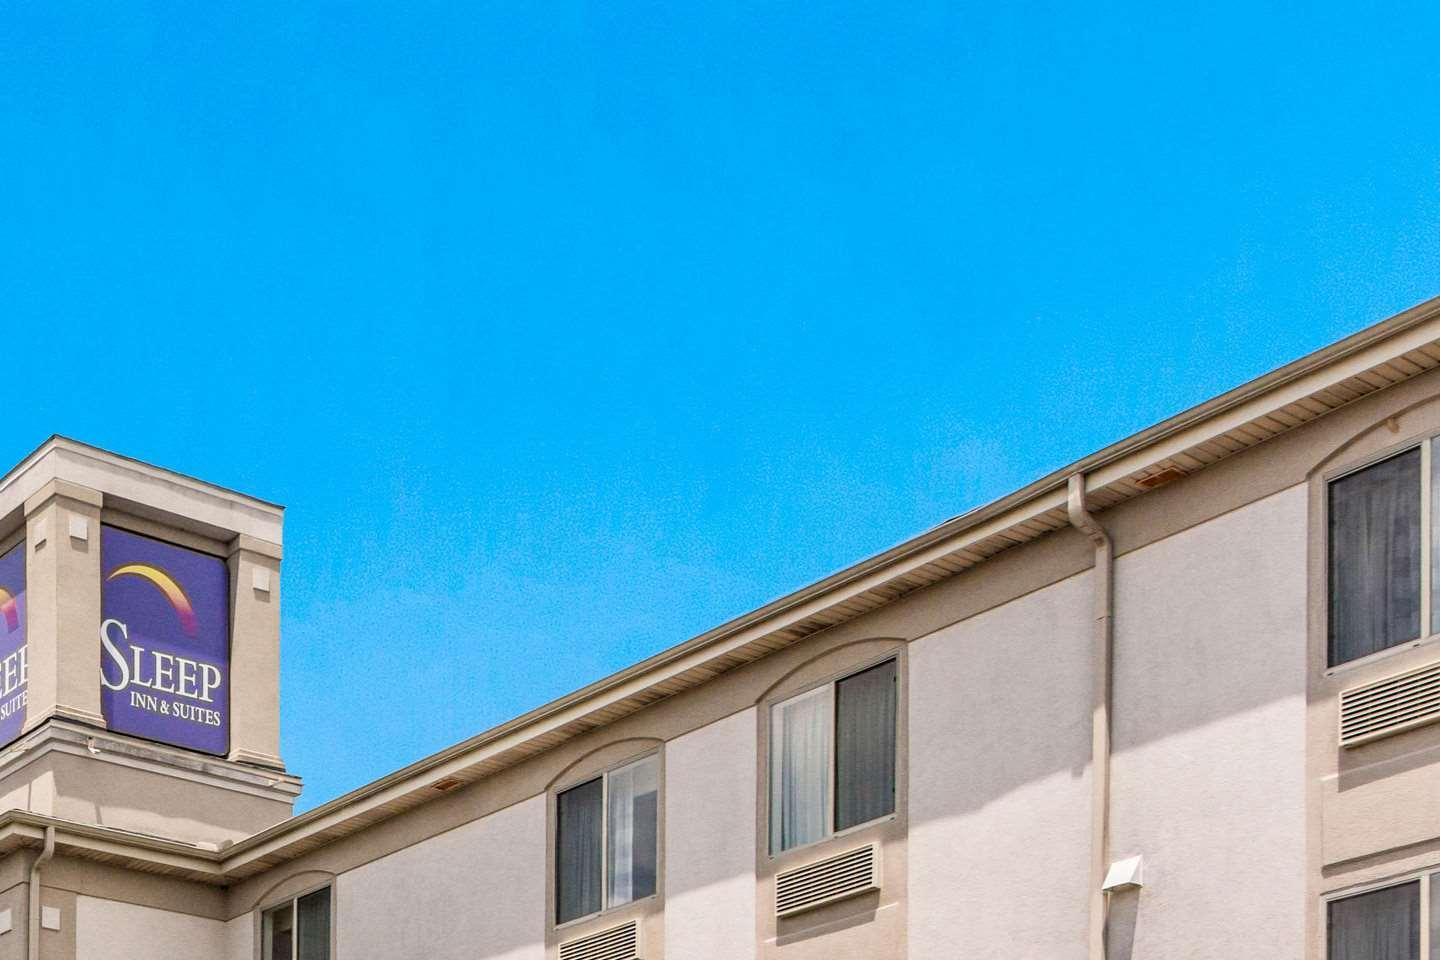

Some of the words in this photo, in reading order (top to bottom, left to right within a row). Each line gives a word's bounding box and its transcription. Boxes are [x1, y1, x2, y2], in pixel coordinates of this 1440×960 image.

[100, 618, 222, 703] SLEEP
[0, 689, 28, 721] SUITE
[129, 690, 158, 713] INN
[160, 700, 170, 715] &
[172, 701, 222, 727] SUITES
